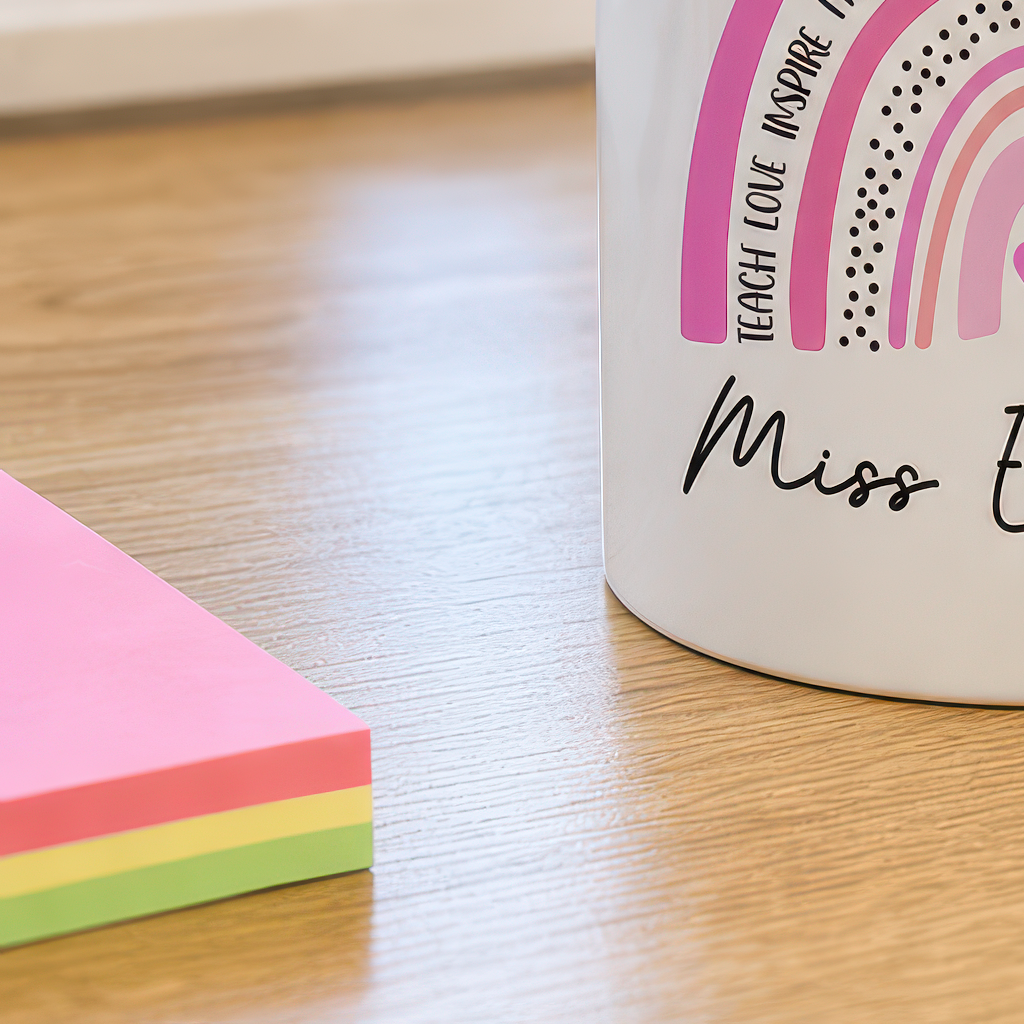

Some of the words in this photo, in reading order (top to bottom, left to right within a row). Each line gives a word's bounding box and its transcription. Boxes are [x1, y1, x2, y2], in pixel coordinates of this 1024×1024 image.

[761, 26, 832, 140] INSPIRE
[744, 155, 786, 230] LOVE
[737, 243, 776, 343] TEACH
[682, 374, 940, 512] Miss
